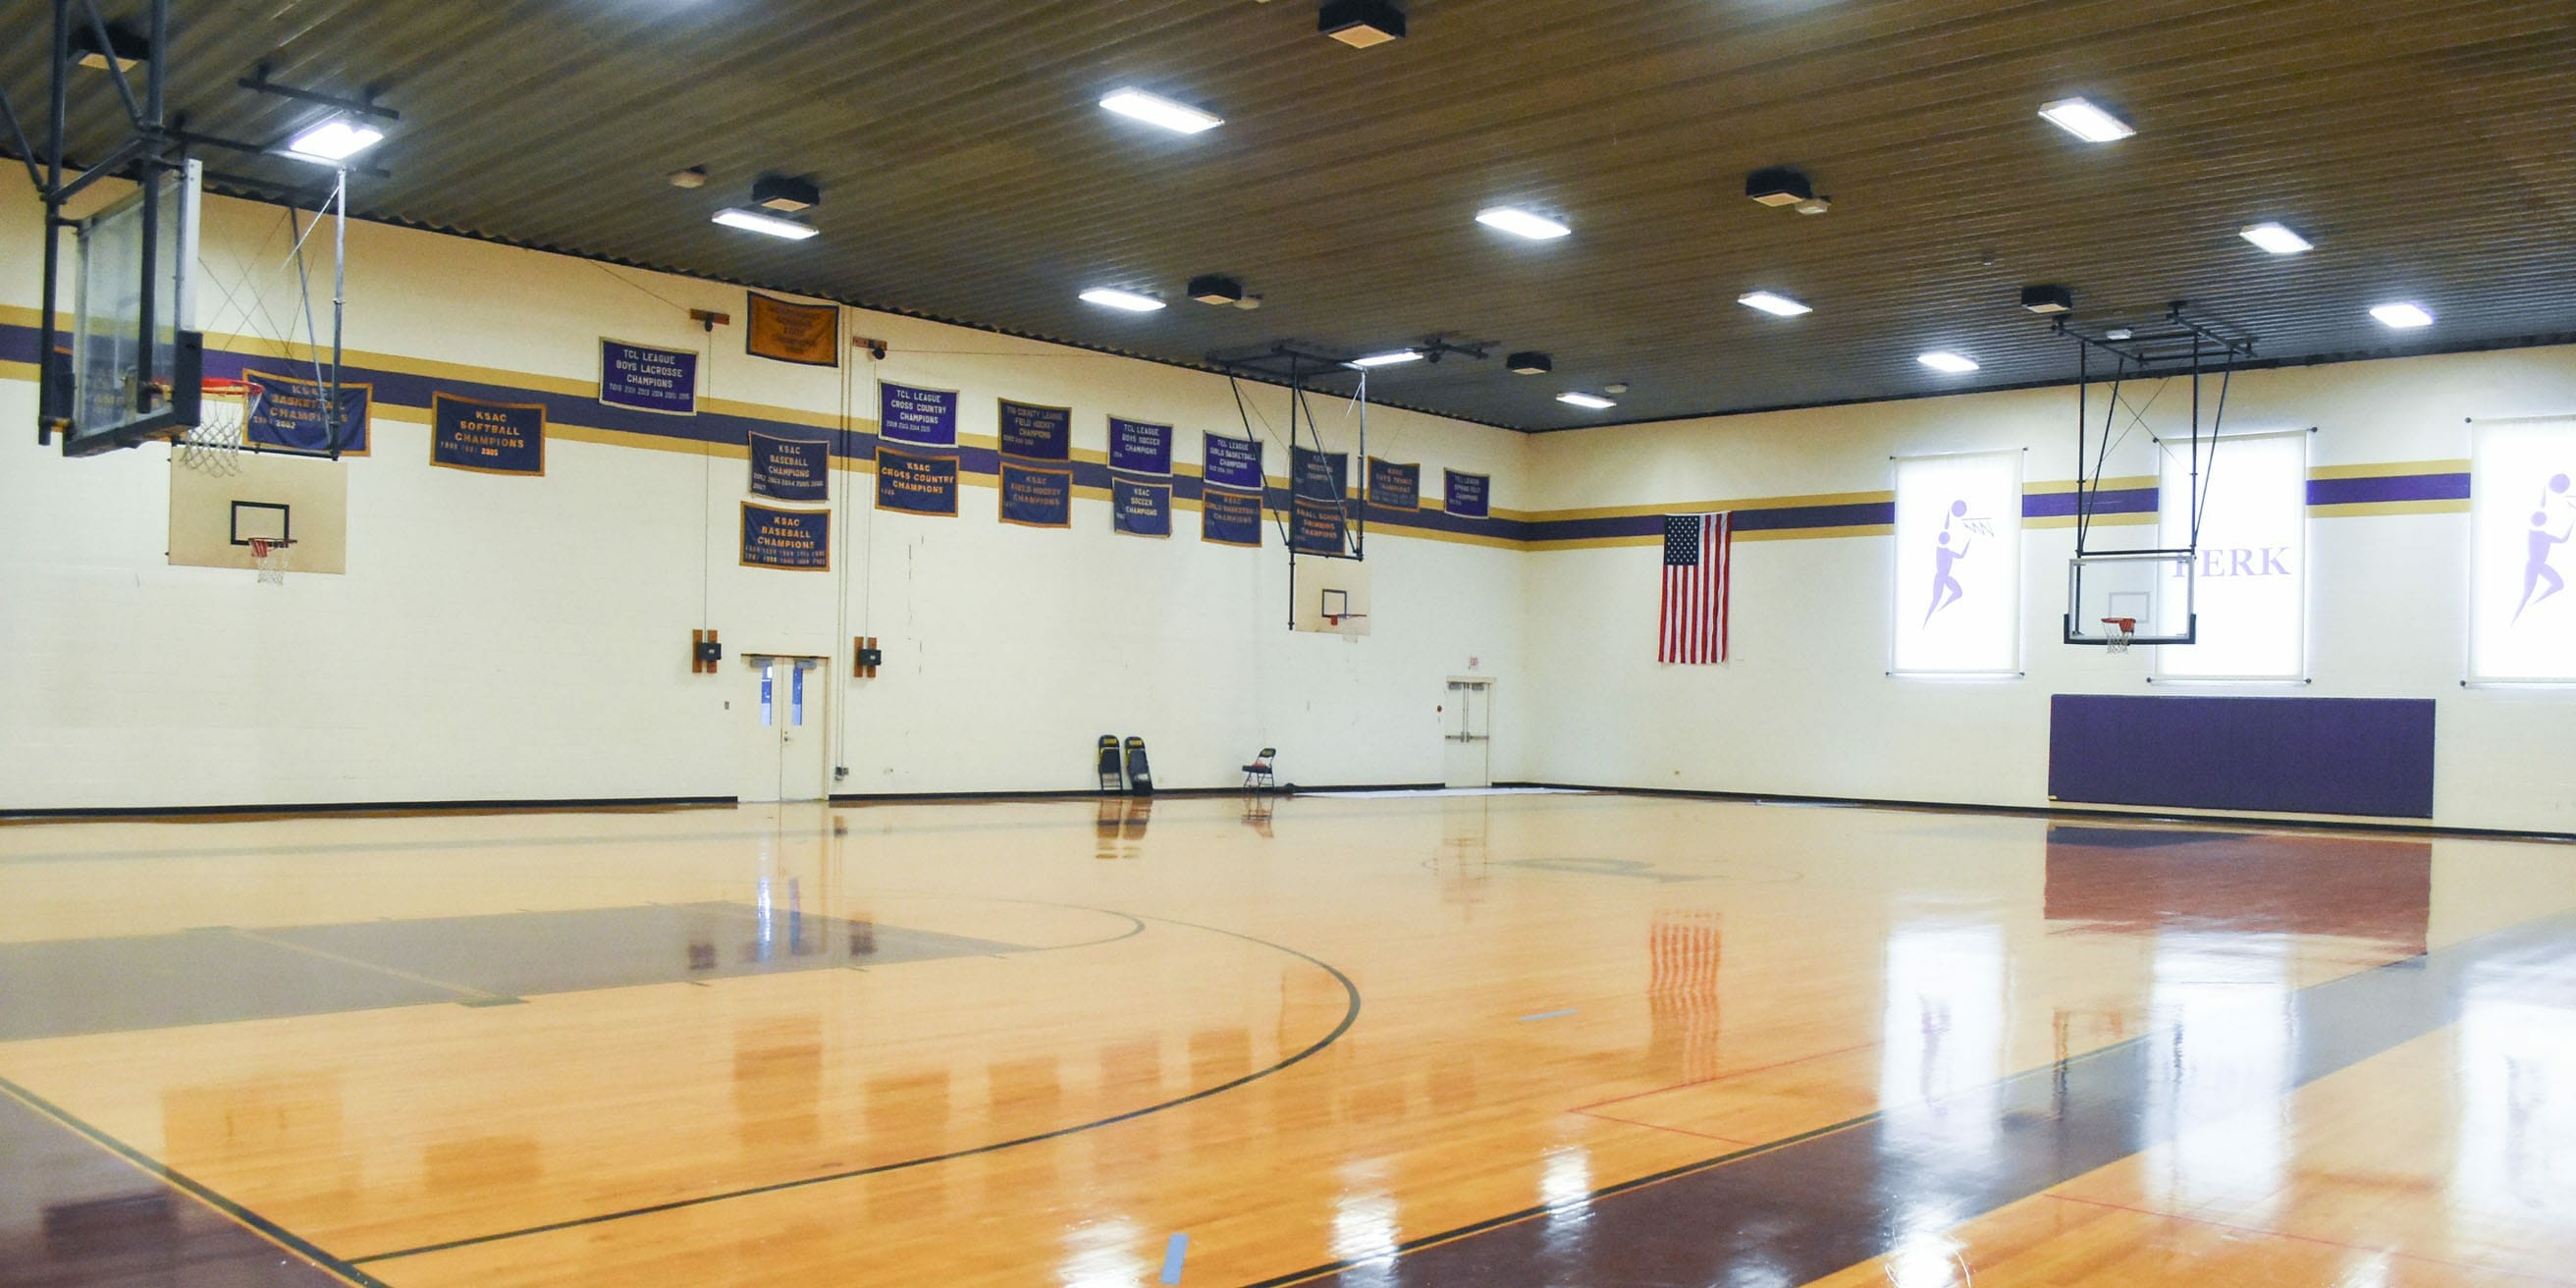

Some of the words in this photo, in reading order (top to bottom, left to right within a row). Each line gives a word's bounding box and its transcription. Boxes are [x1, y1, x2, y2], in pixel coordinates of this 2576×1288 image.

[623, 349, 639, 360] TCL
[642, 351, 675, 364] LEAGUE
[617, 359, 637, 371] BOYS
[640, 364, 683, 378] LACROSSE
[626, 374, 673, 389] CHAMPIONS
[896, 390, 911, 400] TCL
[914, 393, 941, 403] LEAGUE
[891, 400, 914, 410] CROSS
[917, 403, 946, 414] COUNTRY
[475, 410, 508, 422] KSAC
[900, 412, 939, 424] CHAMPIONS
[460, 420, 520, 436] SOFTBALL
[1124, 424, 1135, 433] TCL
[1137, 426, 1159, 436] LEAGUE
[455, 432, 524, 449] CHAMPIONS
[1229, 442, 1249, 451] LEAGUE
[778, 445, 801, 455] KSAC
[1125, 444, 1157, 456] CHAMPIONS
[770, 455, 809, 466] BASEBALL
[906, 462, 931, 472] KSAC
[769, 465, 810, 478] CHAMPIONS
[882, 466, 911, 480] CROSS
[913, 474, 954, 483] COUNTRY
[892, 480, 943, 494] CHAMPIONS
[774, 516, 800, 527] KSAC
[761, 525, 811, 539] BASEBALL
[757, 536, 815, 549] CHAMPIONS
